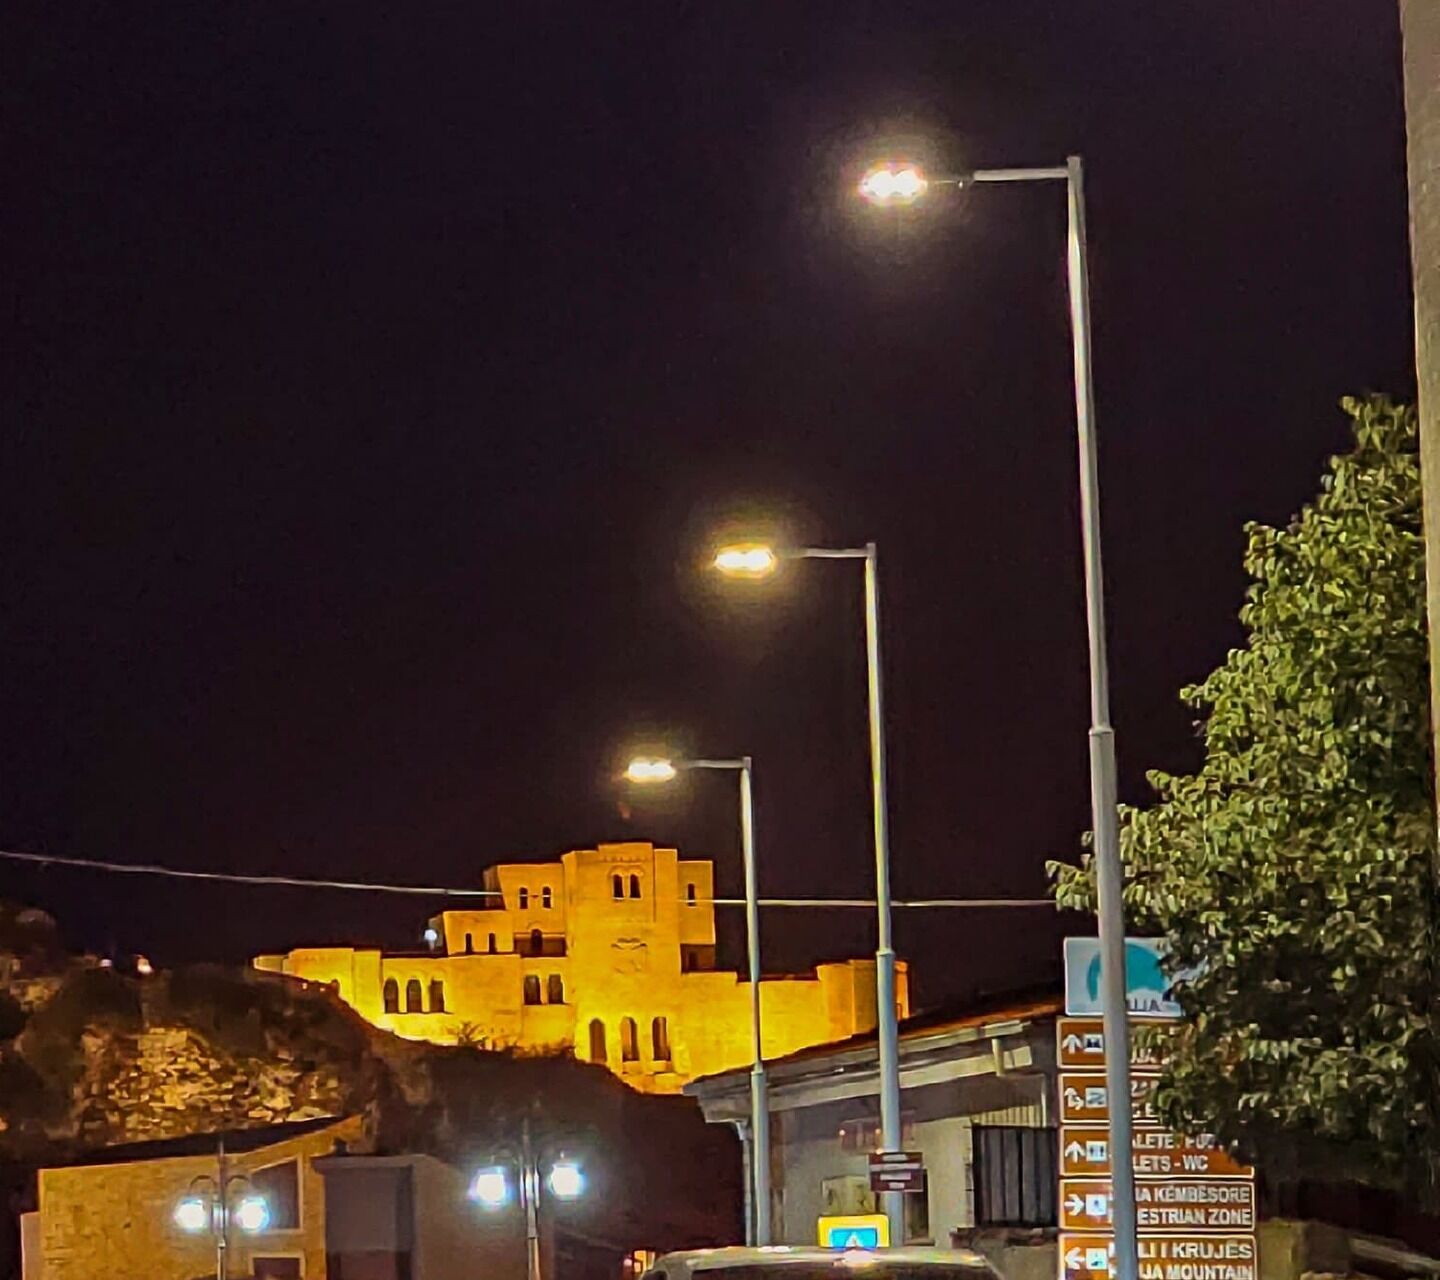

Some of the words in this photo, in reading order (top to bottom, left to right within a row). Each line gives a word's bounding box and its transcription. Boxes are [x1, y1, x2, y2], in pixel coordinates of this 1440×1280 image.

[1182, 1154, 1208, 1171] WC
[1208, 1208, 1252, 1225] ZONE
[1166, 1263, 1253, 1280] MOUNTAIN
